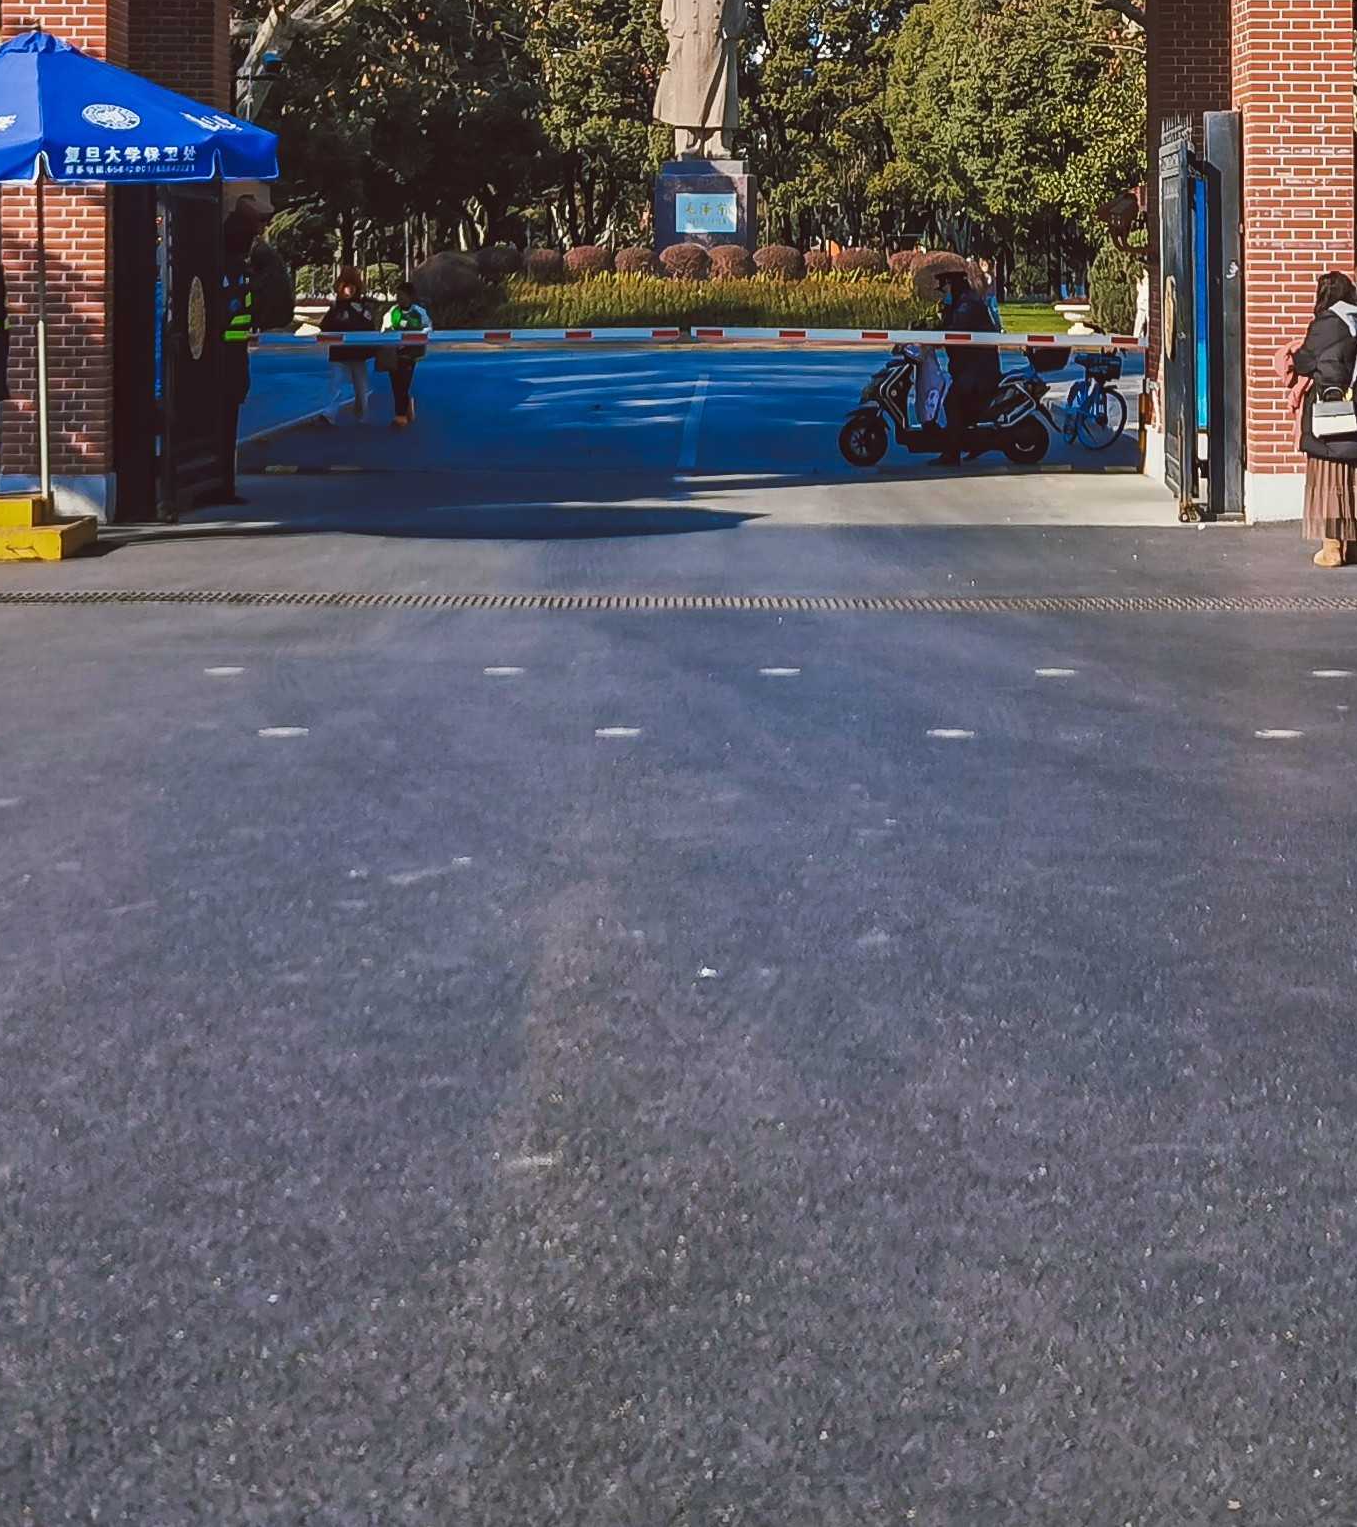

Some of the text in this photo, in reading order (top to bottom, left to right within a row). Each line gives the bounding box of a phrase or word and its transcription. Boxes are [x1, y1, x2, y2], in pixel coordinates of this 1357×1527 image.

[64, 146, 197, 164] 复旦大学保卫处
